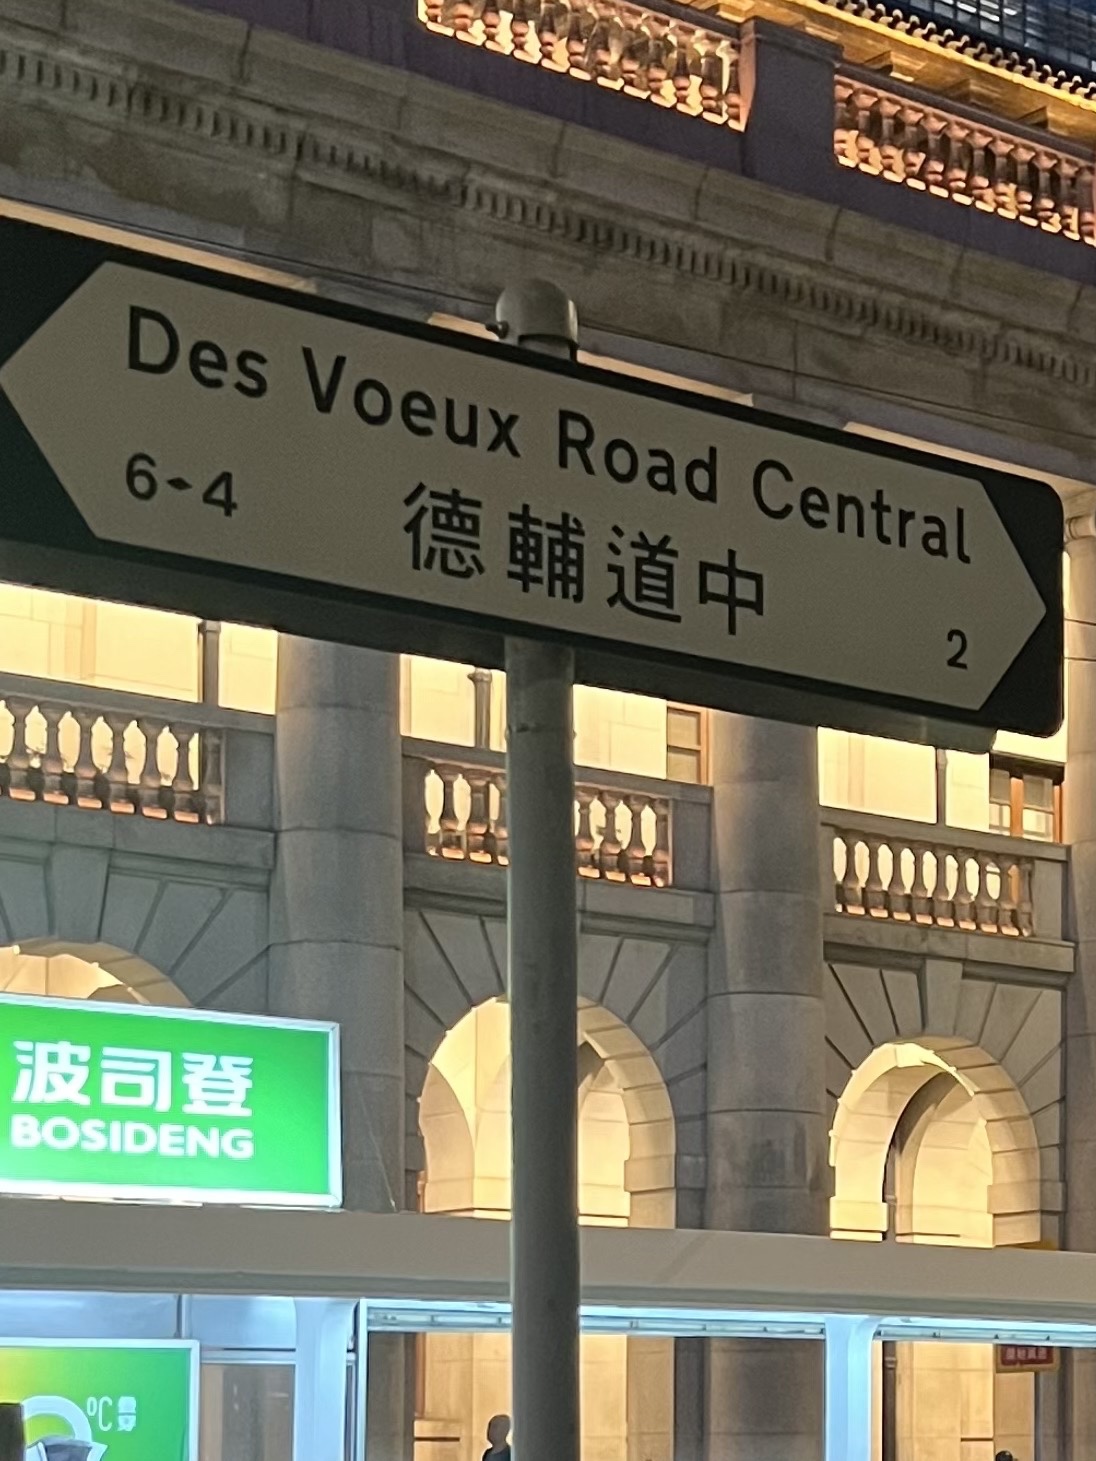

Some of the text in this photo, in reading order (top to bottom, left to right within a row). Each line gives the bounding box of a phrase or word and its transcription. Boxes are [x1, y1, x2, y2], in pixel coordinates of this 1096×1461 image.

[128, 305, 972, 564] Des Voeux Road Central
[126, 452, 238, 518] 6-4
[403, 481, 764, 636] 德輔道中
[946, 628, 968, 670] 2
[12, 1040, 254, 1117] 波司登
[10, 1113, 255, 1160] BOSIDENG
